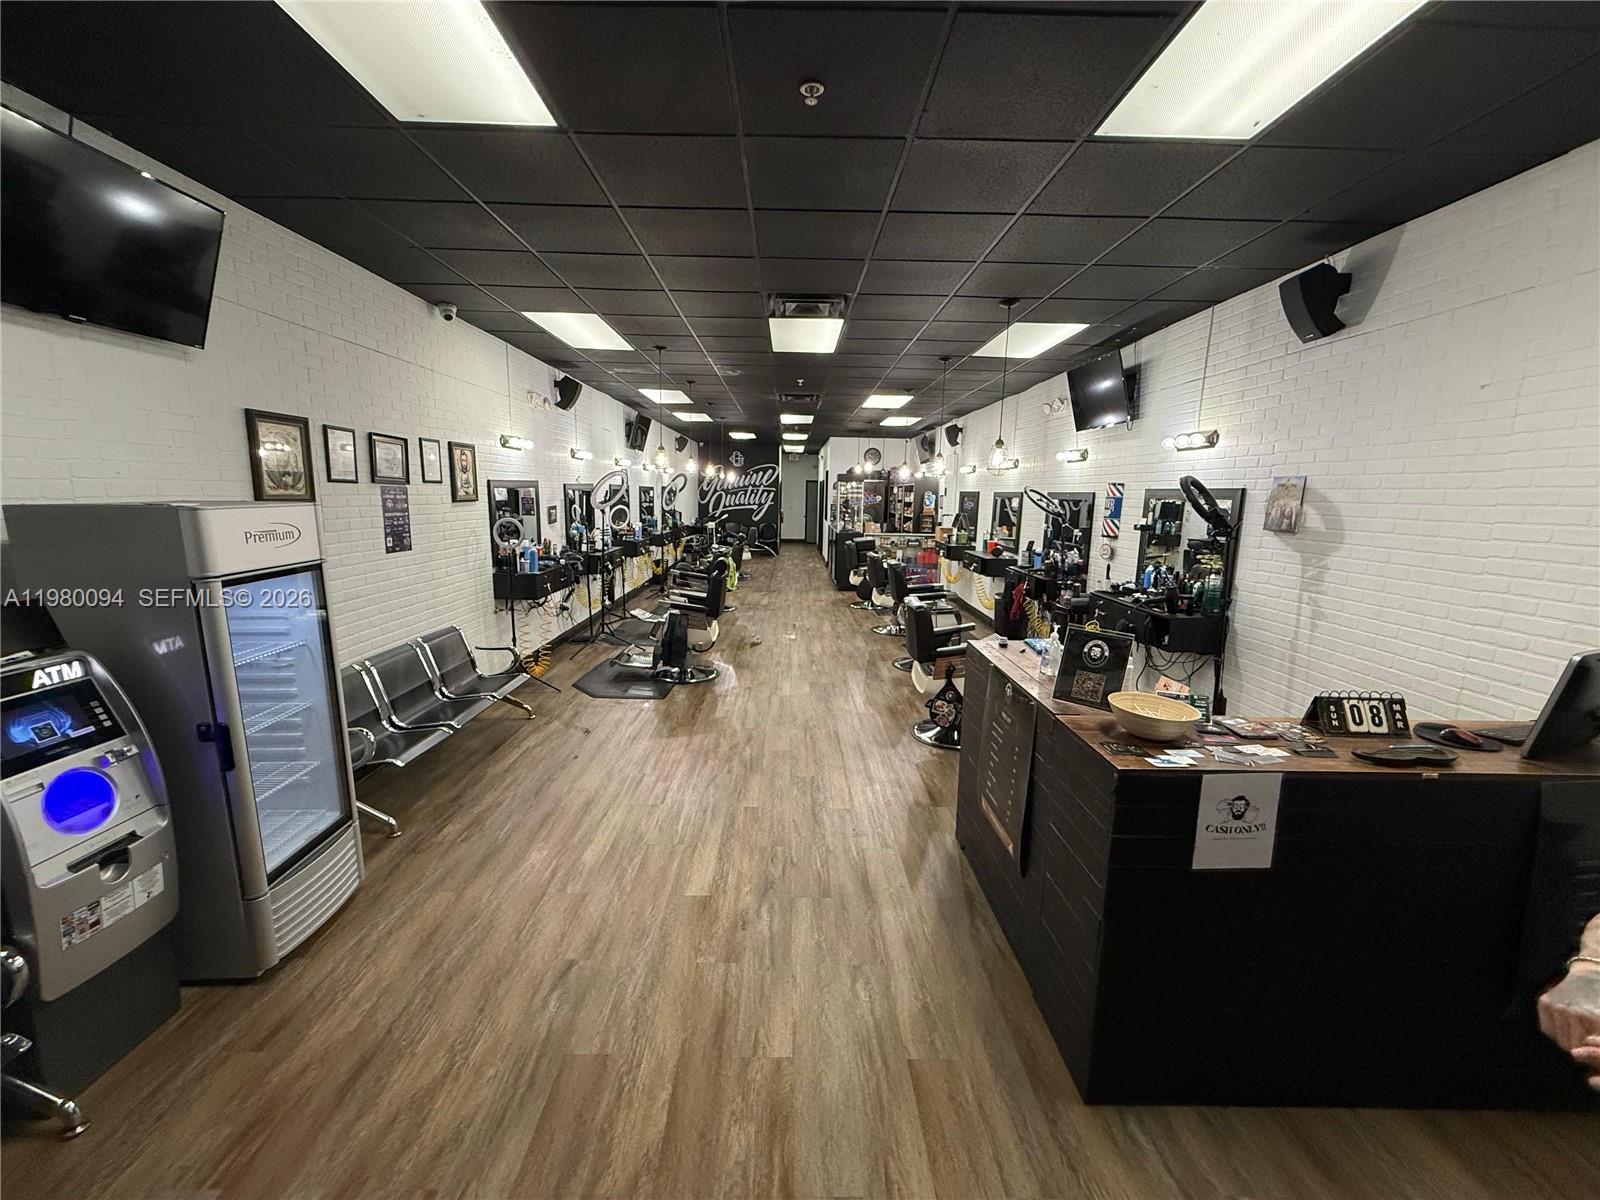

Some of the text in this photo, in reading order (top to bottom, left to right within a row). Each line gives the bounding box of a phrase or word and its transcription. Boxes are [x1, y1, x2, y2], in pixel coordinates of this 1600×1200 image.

[708, 485, 776, 521] Quality
[244, 530, 295, 544] Premium
[31, 660, 83, 689] ATM
[1329, 705, 1339, 726] SUN
[1349, 703, 1384, 727] 08
[1392, 703, 1405, 729] MAR
[1205, 824, 1232, 834] CASH
